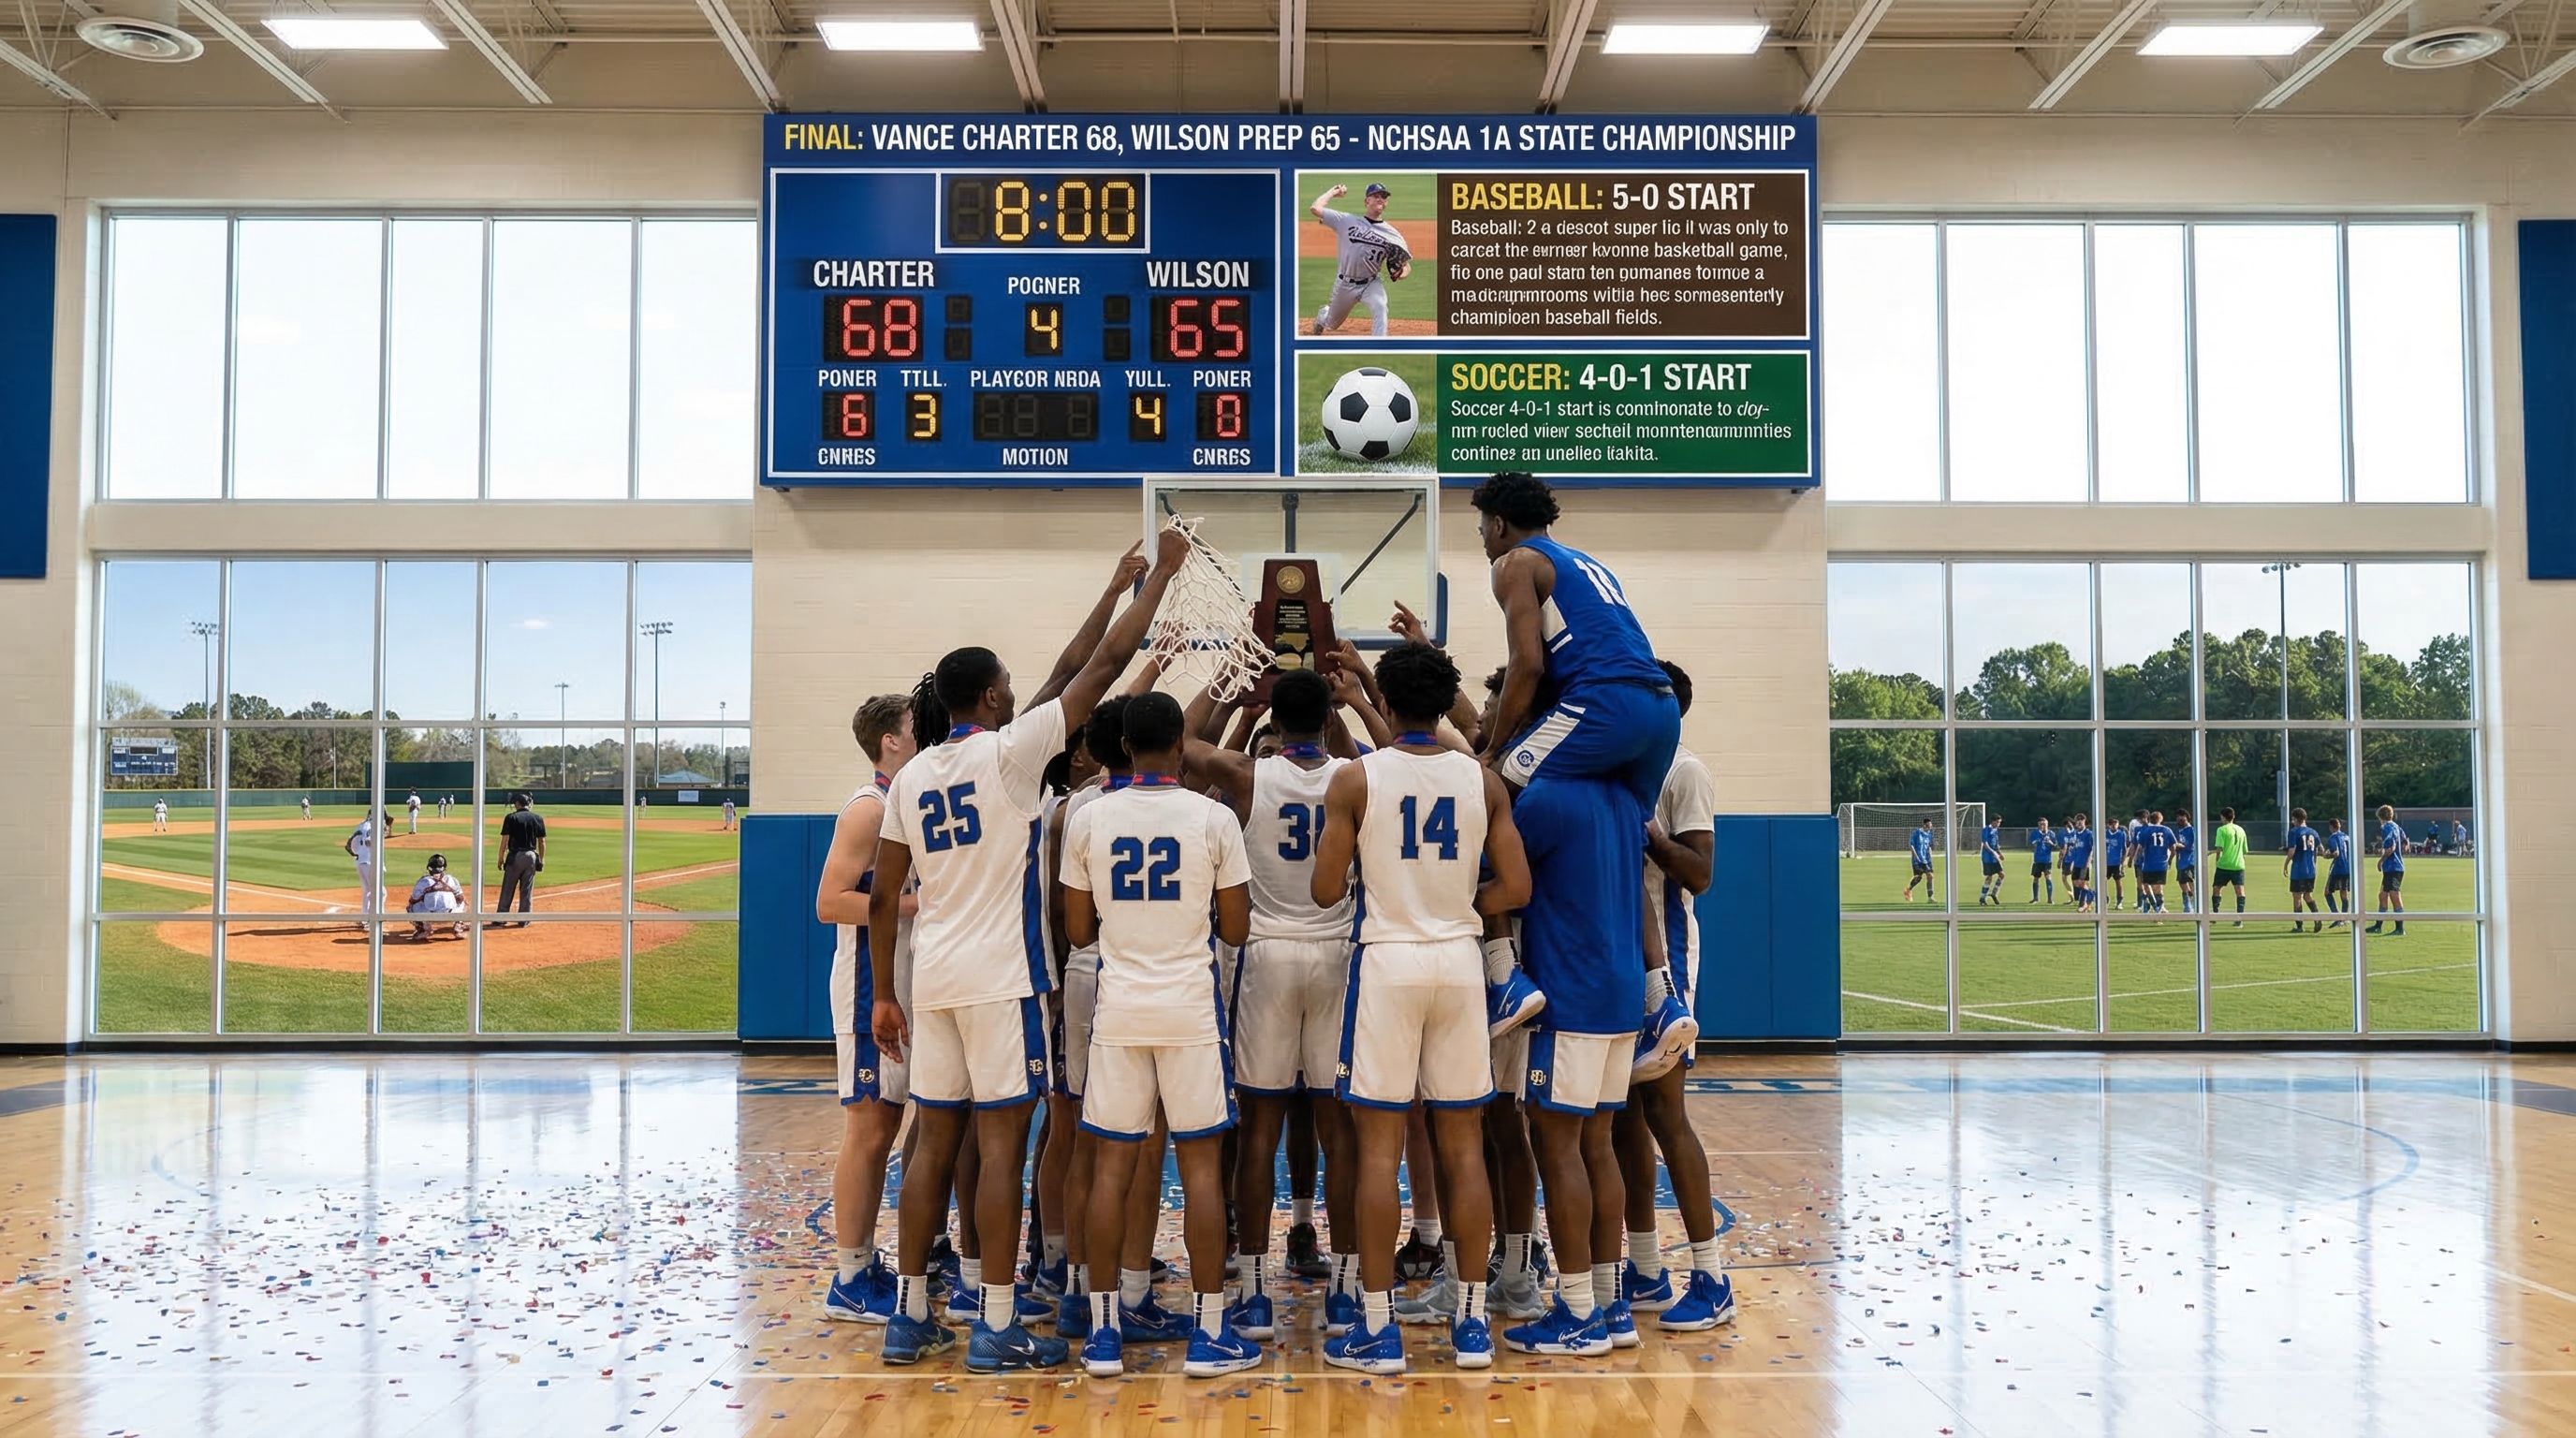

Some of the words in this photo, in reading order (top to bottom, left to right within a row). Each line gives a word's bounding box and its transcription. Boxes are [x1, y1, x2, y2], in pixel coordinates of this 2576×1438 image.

[784, 124, 863, 150] FINAL:
[871, 124, 954, 151] VANCE
[963, 124, 1078, 151] CHARTER
[1086, 124, 1124, 156] 68,
[1132, 124, 1229, 151] WILSON
[1238, 125, 1303, 151] PREP
[1311, 125, 1340, 152] 65
[1368, 125, 1471, 152] NCHSAA
[1479, 125, 1512, 152] 1A
[1518, 125, 1595, 152] STATE
[1603, 125, 1796, 152] CHAMPIONSHIP
[1452, 183, 1603, 211] BASEBALL:
[1612, 183, 1660, 211] 5-0
[1668, 183, 1755, 211] START
[995, 181, 1135, 242] 8:00
[1451, 218, 1522, 236] Baseball:
[1527, 219, 1537, 235] 2
[1557, 219, 1609, 235] descot
[1615, 219, 1658, 239] super
[1699, 223, 1732, 235] was
[1735, 219, 1769, 239] only
[1773, 220, 1789, 235] to
[1504, 242, 1530, 258] the
[1654, 242, 1734, 258] basketball
[1739, 244, 1788, 261] game,
[813, 259, 935, 287] CHARTER
[1007, 276, 1080, 295] POGNER
[1146, 260, 1250, 288] WILSON
[1475, 267, 1504, 280] one
[1589, 265, 1615, 280] ten
[1755, 268, 1765, 280] a
[842, 299, 916, 358] 68
[1031, 308, 1058, 350] 4
[1170, 299, 1244, 358] 65
[1545, 308, 1610, 325] baseball
[1616, 308, 1662, 325] fields.
[818, 369, 877, 388] PONER
[900, 369, 947, 388] TTLL.
[1124, 370, 1171, 388] YULL.
[1193, 370, 1251, 388] PONER
[1451, 362, 1570, 391] SOCCER:
[1579, 363, 1651, 391] 4-0-1
[1663, 363, 1752, 391] START
[842, 393, 867, 437] 6
[914, 394, 936, 437] 3
[1135, 396, 1161, 435] 4
[1451, 400, 1505, 417] Soccer
[1509, 401, 1550, 417] 4-0-1
[1558, 401, 1594, 417] start
[1598, 401, 1612, 417] is
[1718, 402, 1733, 417] to
[1003, 448, 1069, 466] MOTION
[917, 781, 982, 854] 25
[1399, 795, 1459, 860] 14
[1110, 836, 1181, 902] 22
